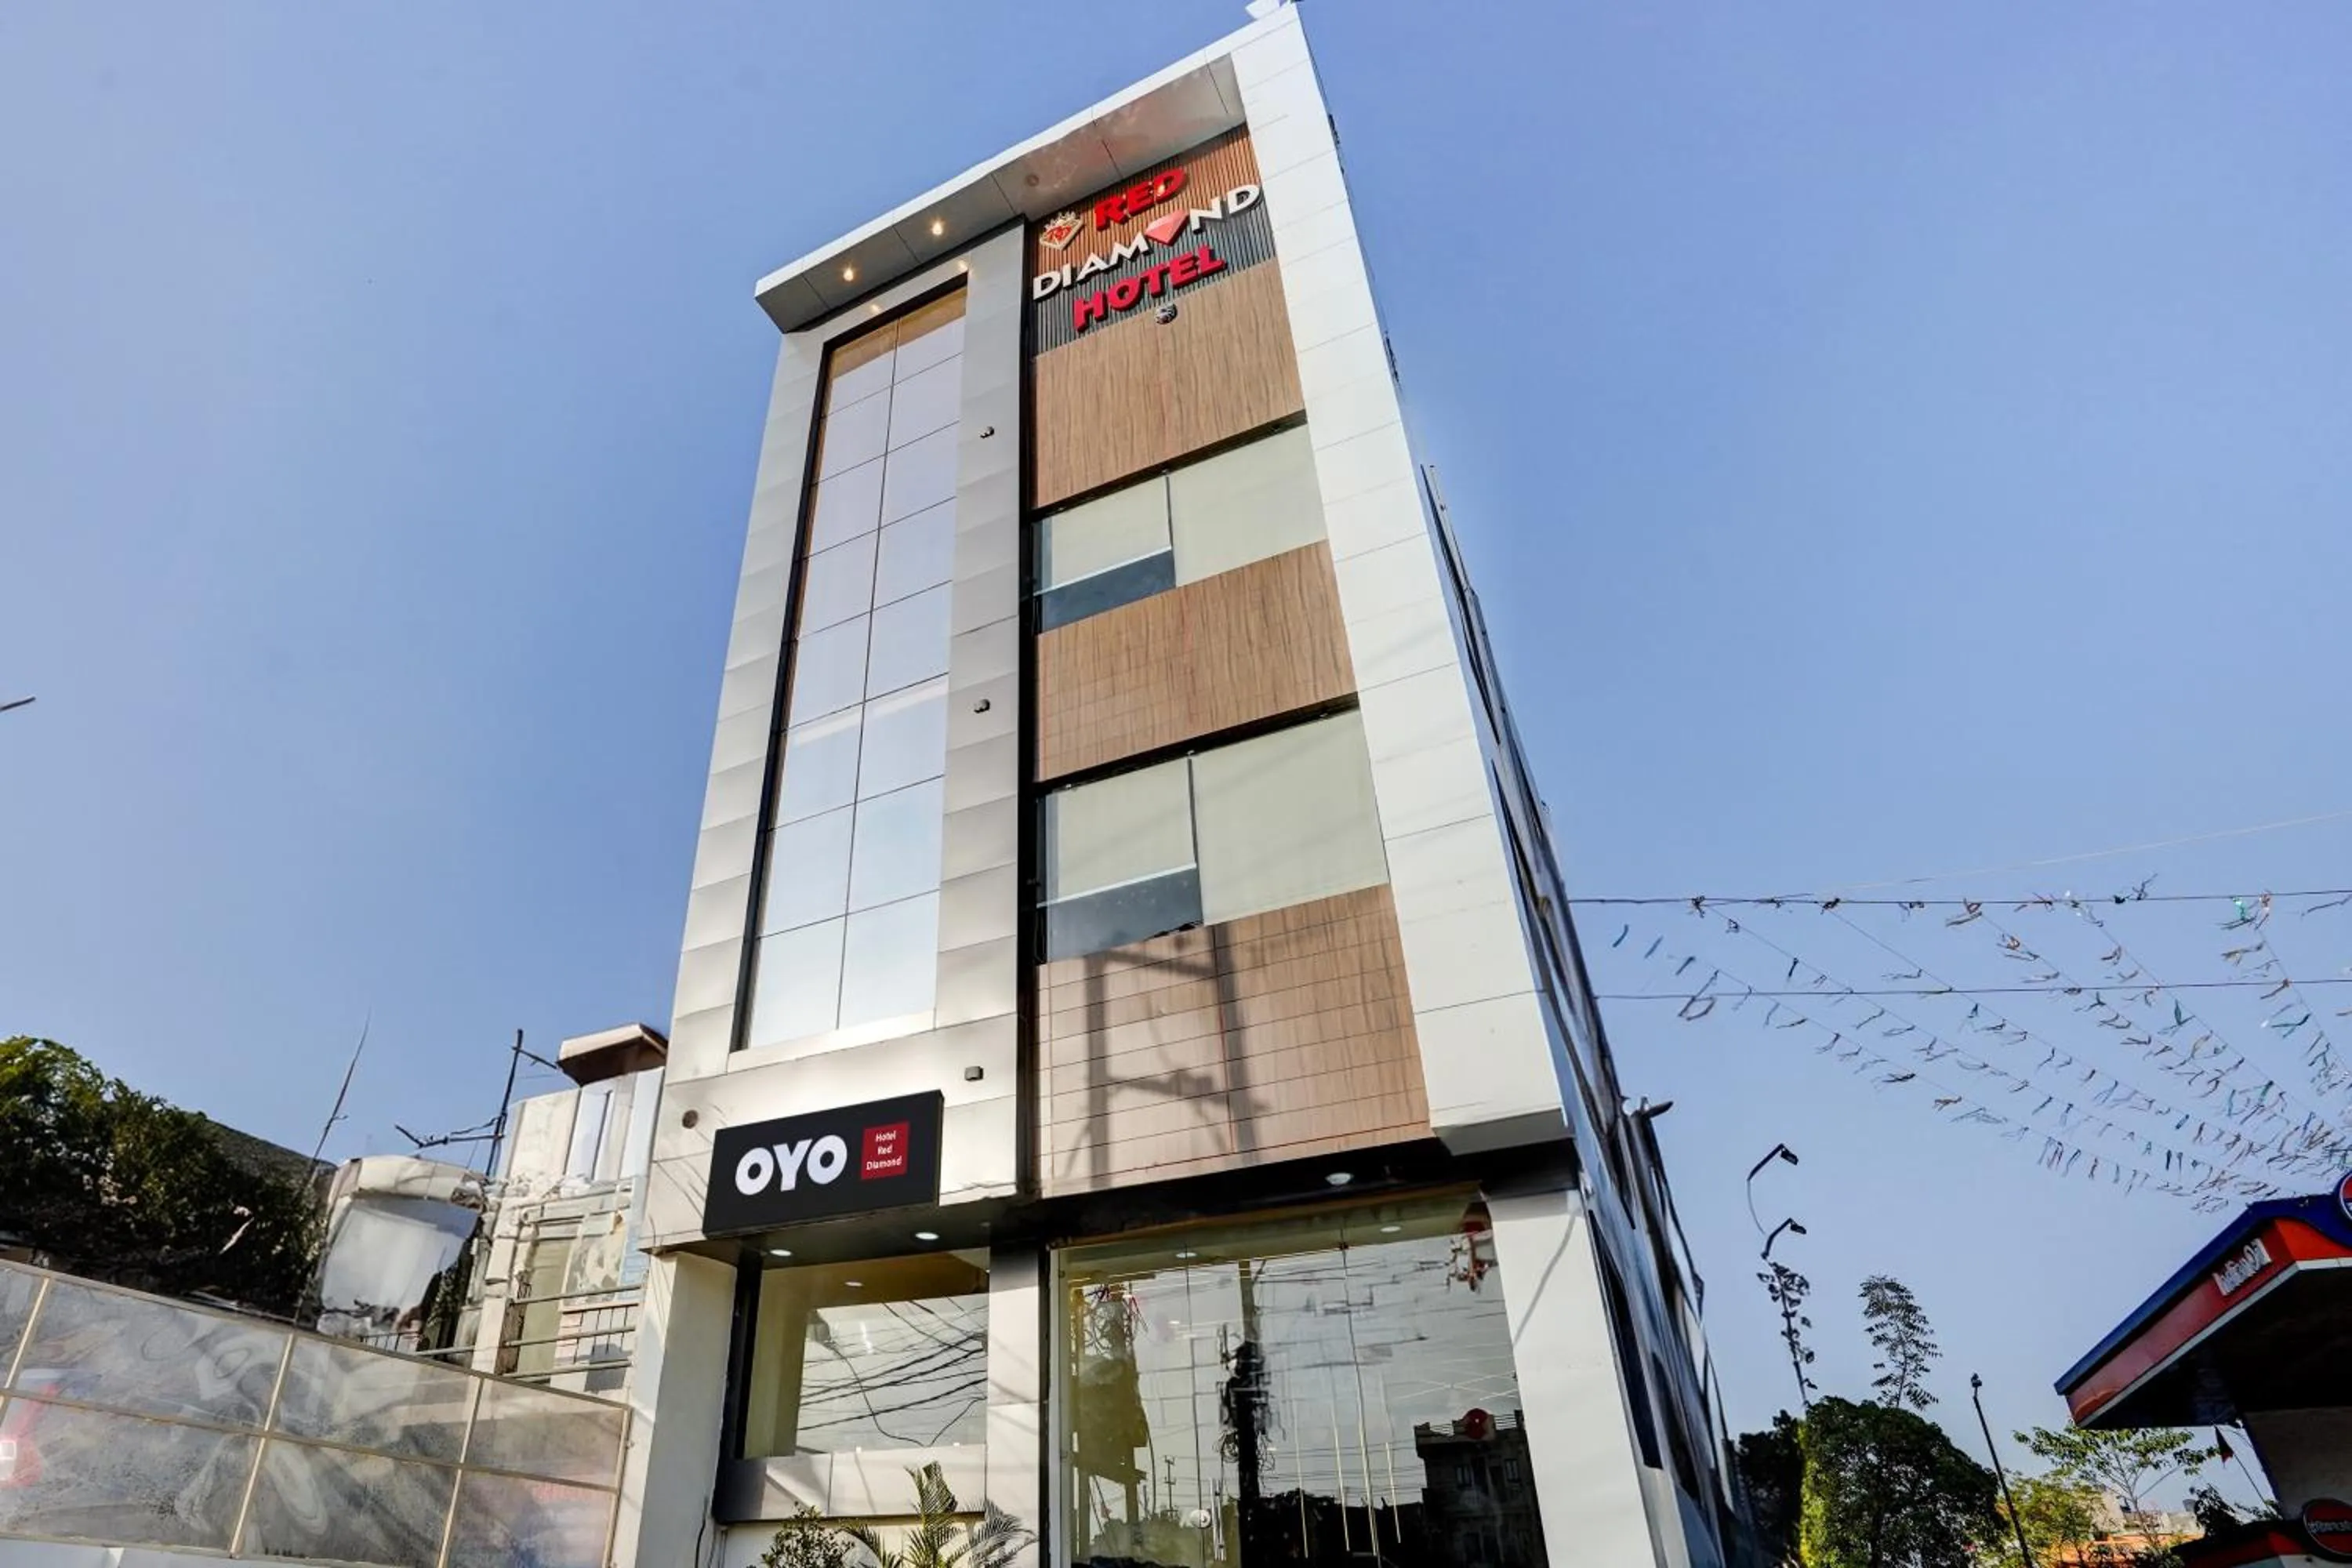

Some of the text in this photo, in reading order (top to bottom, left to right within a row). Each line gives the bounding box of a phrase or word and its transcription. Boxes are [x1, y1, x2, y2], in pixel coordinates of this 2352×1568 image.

[1094, 165, 1187, 230] RED
[1033, 184, 1261, 299] DIAMND
[1073, 242, 1226, 332] HOTEL
[735, 1134, 848, 1196] OYO
[866, 1155, 902, 1171] Diamond
[875, 1130, 896, 1142] Hotel
[877, 1144, 893, 1155] Red
